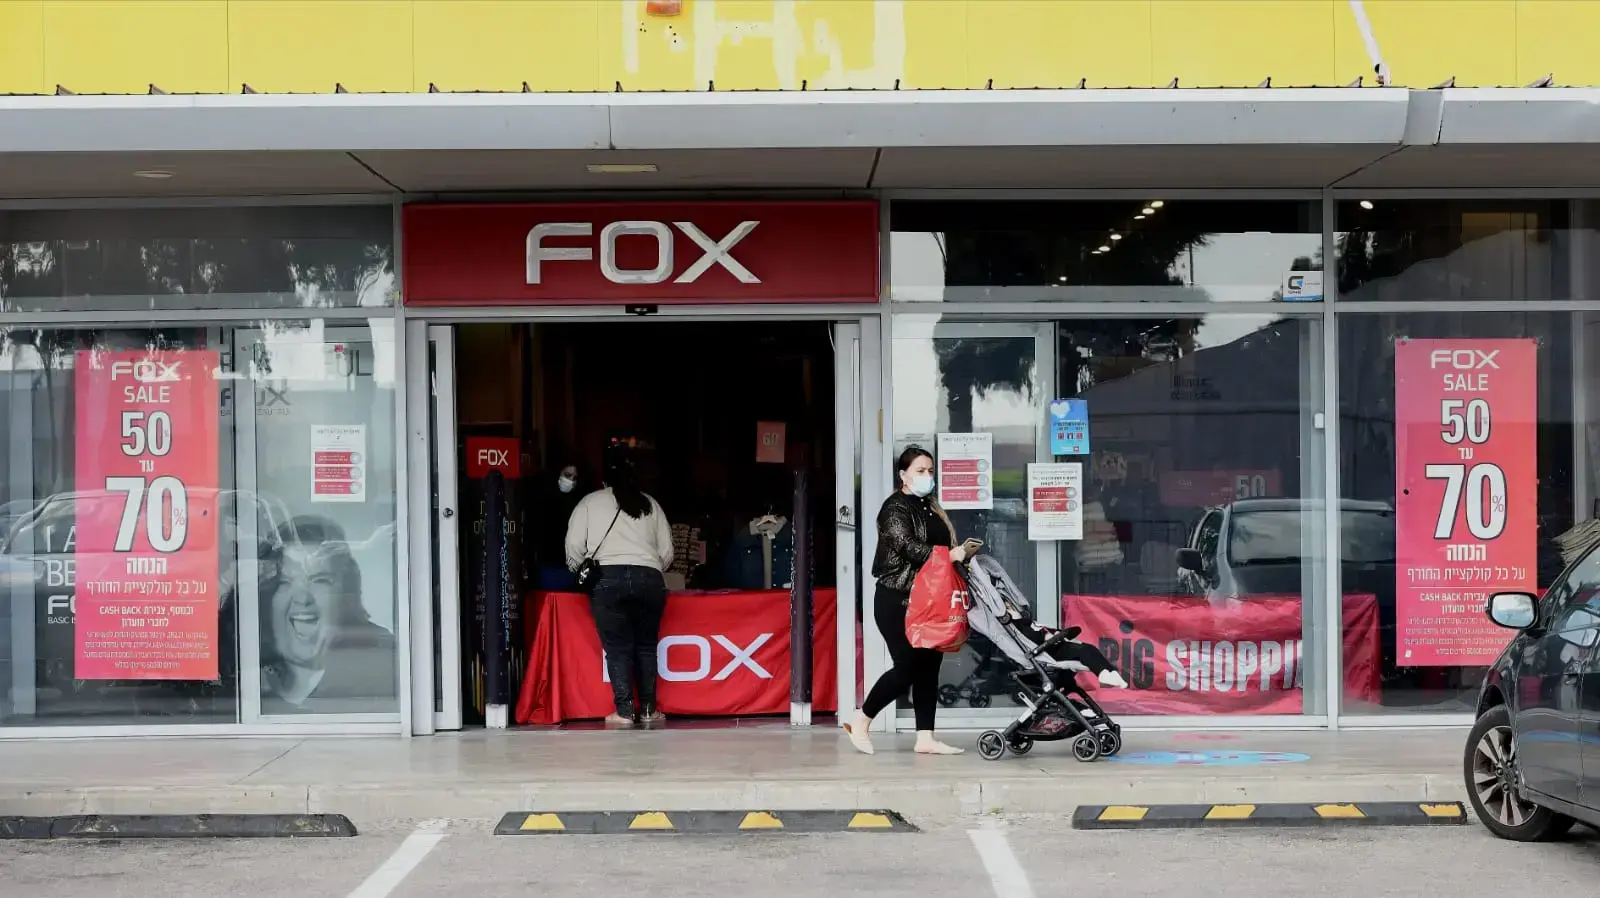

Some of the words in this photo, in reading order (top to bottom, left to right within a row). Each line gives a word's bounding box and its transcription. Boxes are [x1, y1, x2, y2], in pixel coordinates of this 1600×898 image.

[525, 220, 763, 284] FOX
[1430, 349, 1500, 369] FOX
[111, 361, 182, 382] FOX
[1443, 373, 1489, 392] SALE
[124, 386, 171, 403] SALE
[478, 449, 509, 466] FOX
[1457, 447, 1474, 460] עד
[138, 459, 155, 473] עד
[1446, 544, 1487, 561] הנחה
[126, 557, 168, 575] הנחה
[1407, 566, 1441, 582] החורף
[1444, 565, 1492, 583] קולקציית
[1495, 566, 1508, 580] כל
[1511, 565, 1526, 580] על
[86, 580, 121, 597] החורף
[123, 580, 172, 597] קולקציית
[175, 581, 189, 595] כל
[192, 581, 207, 595] על
[1420, 592, 1441, 602] CASH
[1442, 592, 1461, 602] BACK
[99, 605, 119, 615] CASH
[121, 605, 141, 615] BACK
[47, 616, 69, 624] BASIC
[603, 632, 774, 684] OX
